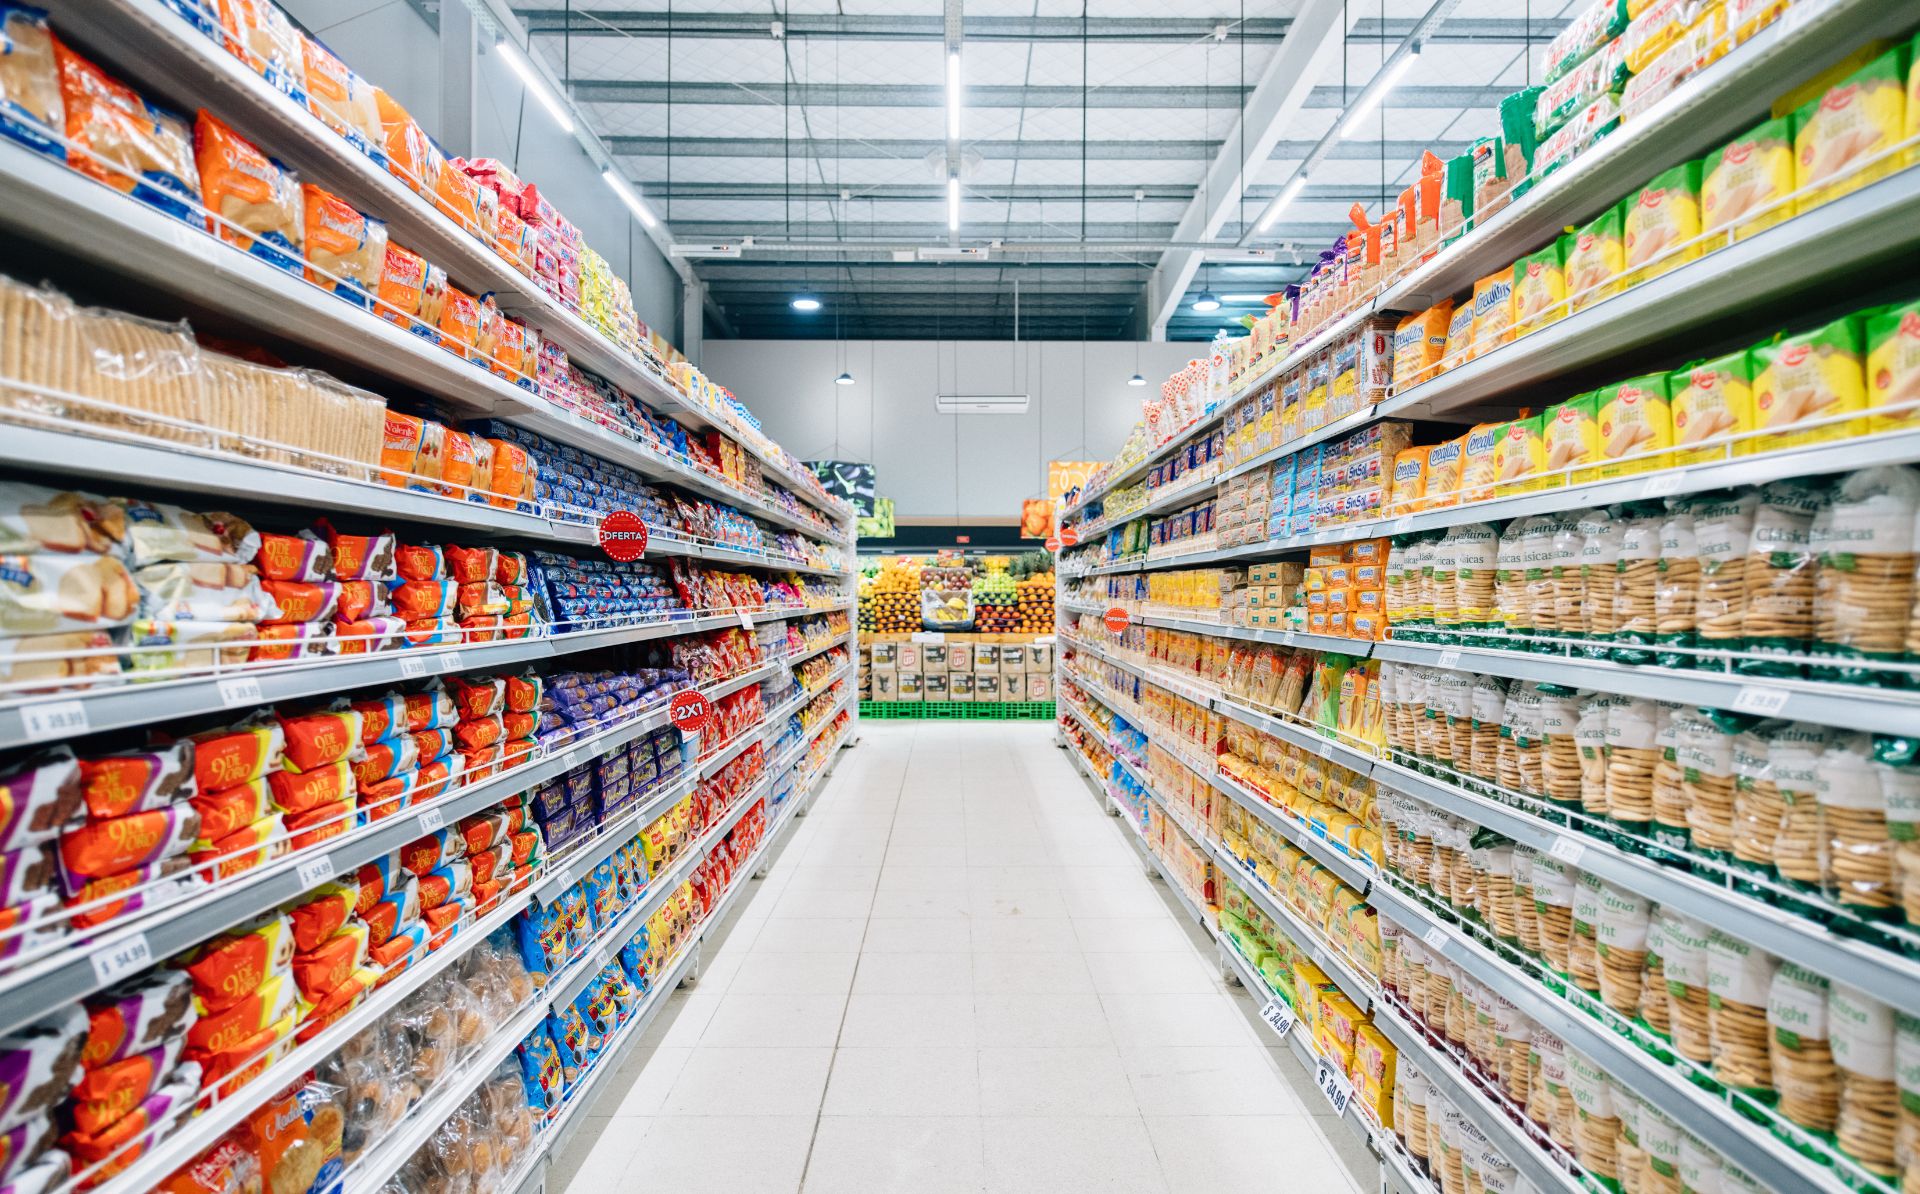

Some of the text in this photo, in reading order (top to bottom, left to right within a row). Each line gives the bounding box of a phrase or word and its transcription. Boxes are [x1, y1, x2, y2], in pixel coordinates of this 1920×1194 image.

[603, 530, 643, 541] OFERTA
[676, 702, 704, 721] 2X1
[212, 753, 240, 784] 9 DE
[225, 766, 251, 781] ORO
[1263, 1005, 1290, 1034] $ 34.99
[1319, 1069, 1326, 1085] $
[1326, 1079, 1346, 1111] 34.99
